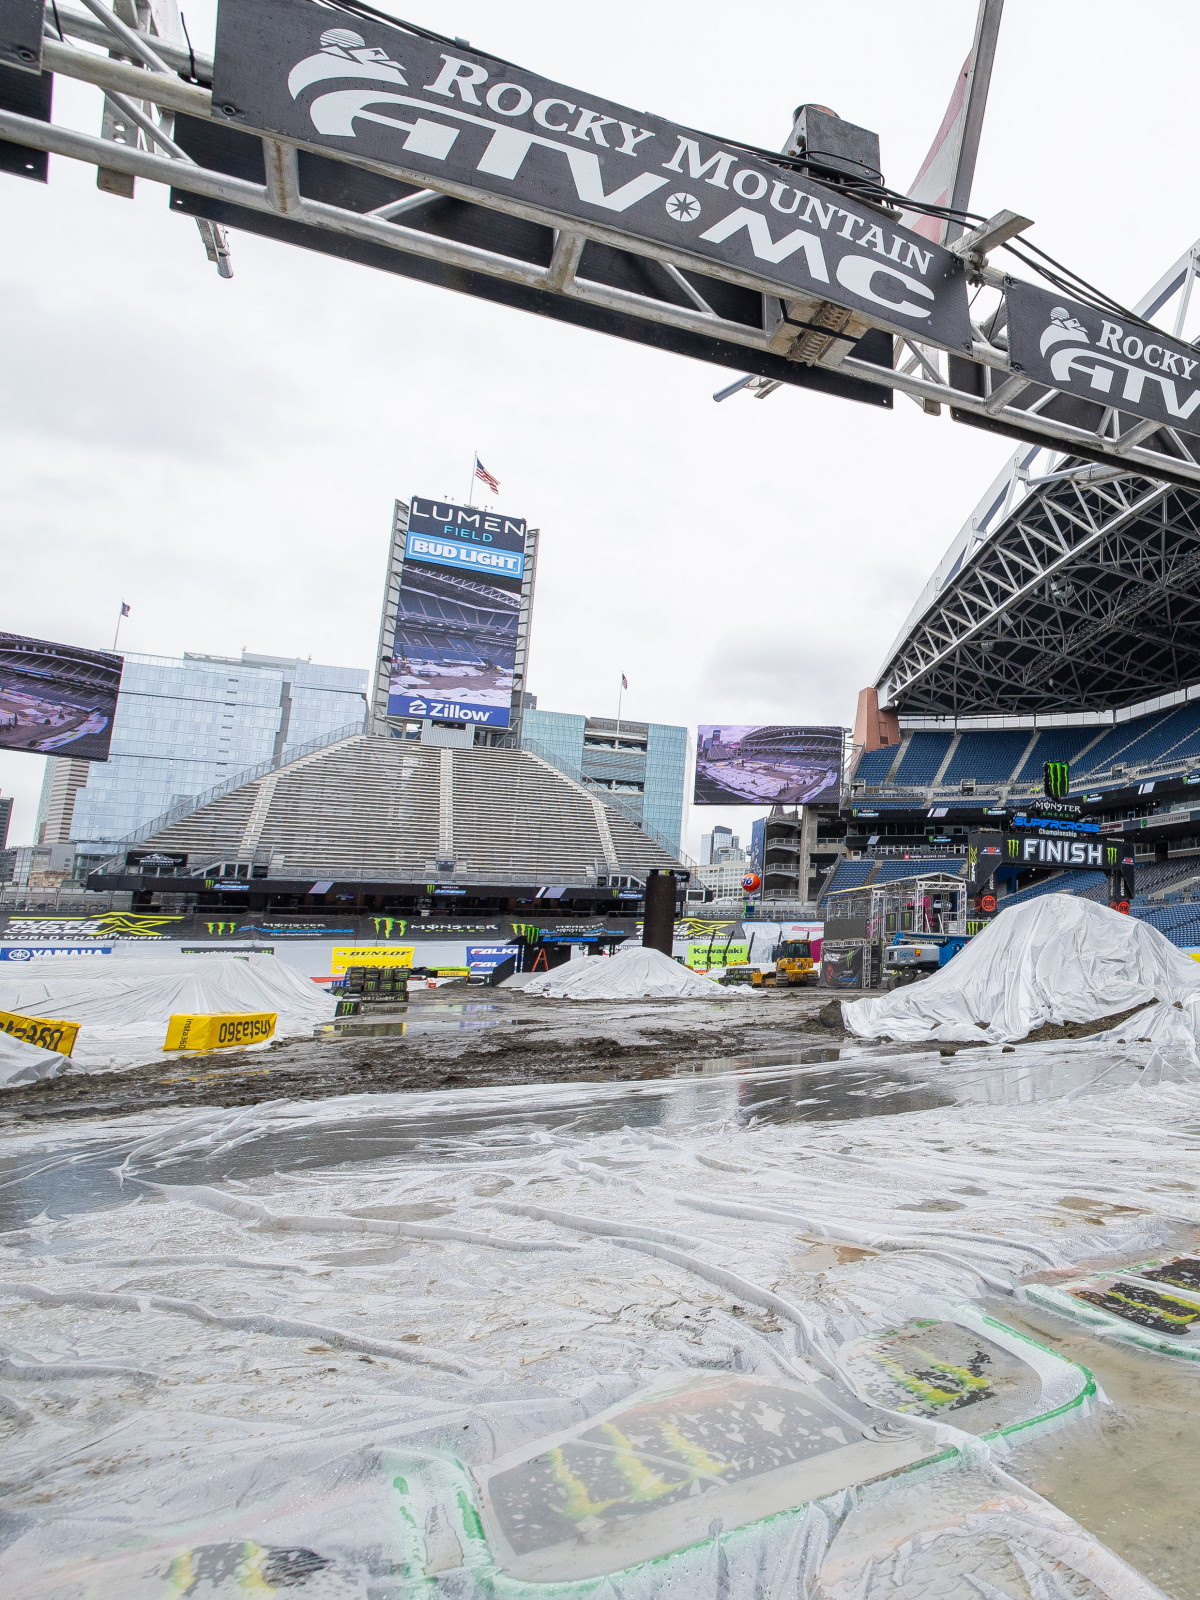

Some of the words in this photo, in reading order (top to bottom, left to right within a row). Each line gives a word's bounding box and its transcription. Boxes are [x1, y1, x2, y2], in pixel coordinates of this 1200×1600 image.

[310, 89, 671, 213] ATV
[423, 53, 655, 158] ROCKY
[662, 134, 934, 276] MOUNTAIN
[1096, 319, 1199, 381] ROCKY
[412, 501, 525, 537] LUMEN
[444, 525, 493, 543] FIELD
[413, 539, 458, 558] BUD
[459, 548, 518, 571] LIGHT
[429, 702, 490, 721] Zillow
[1035, 800, 1082, 814] MONSTER
[1014, 816, 1101, 833] SUPERCROSS
[1038, 827, 1078, 838] Championship
[1023, 838, 1103, 866] FINISH
[63, 932, 171, 941] CHAMPIONSHIP
[179, 1018, 195, 1049] Insta360
[218, 1019, 272, 1043] Insta360
